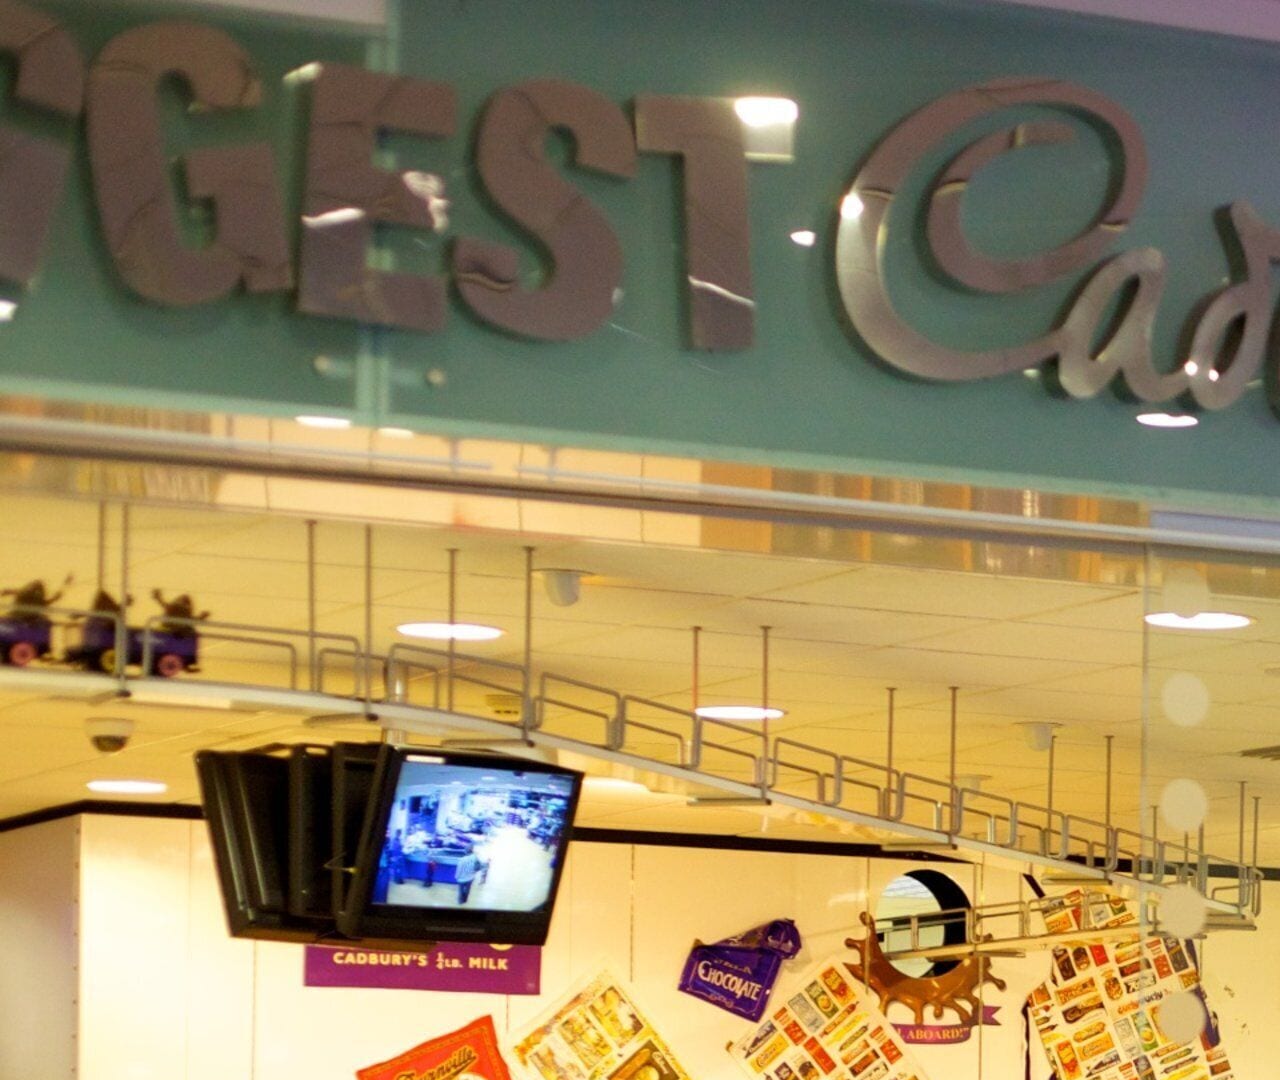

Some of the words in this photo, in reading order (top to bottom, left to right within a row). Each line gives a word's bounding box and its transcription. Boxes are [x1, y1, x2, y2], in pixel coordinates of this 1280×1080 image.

[333, 952, 429, 968] CADBURY'S
[468, 957, 509, 970] MILK
[697, 960, 764, 1001] CHOCOLATE
